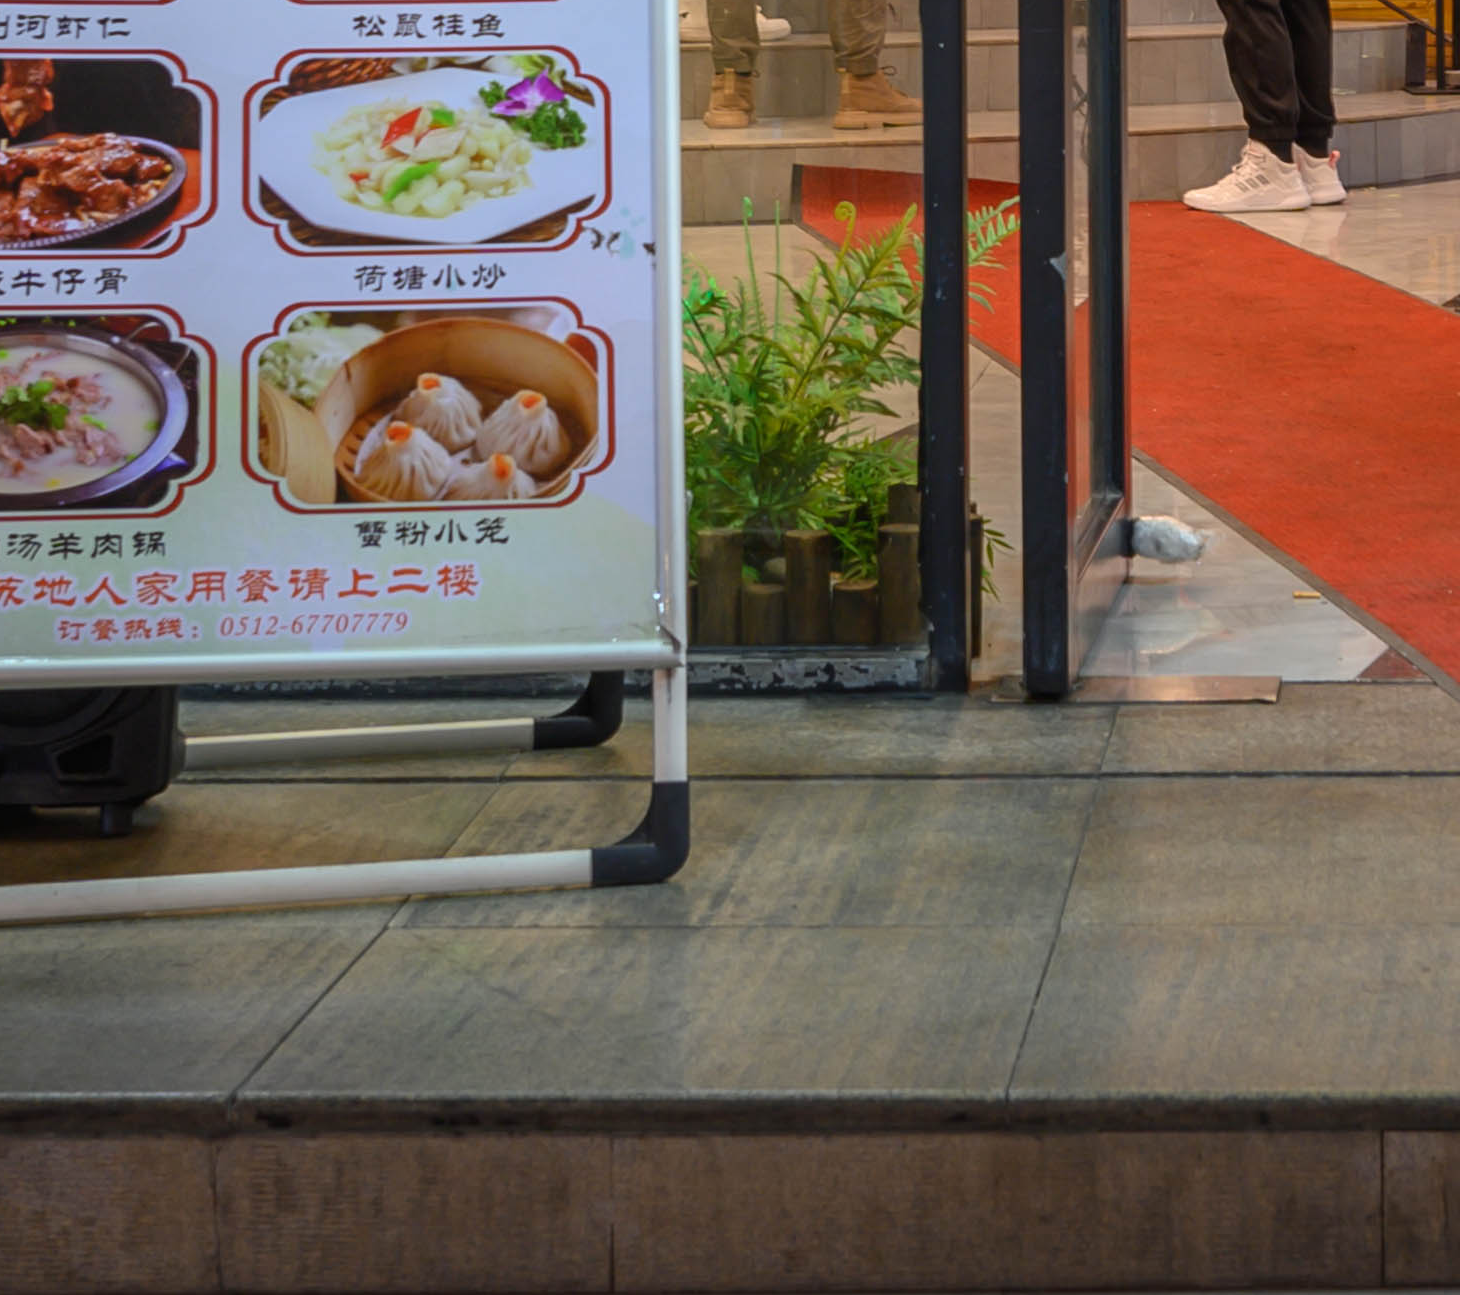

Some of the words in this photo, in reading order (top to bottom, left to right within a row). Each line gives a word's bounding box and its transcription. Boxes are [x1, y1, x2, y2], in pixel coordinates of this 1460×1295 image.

[352, 12, 506, 40] 松鼠桂鱼
[355, 263, 508, 292] 荷塘小炒
[355, 517, 511, 551] 蟹粉小笼
[219, 612, 409, 638] 0512-67707779
